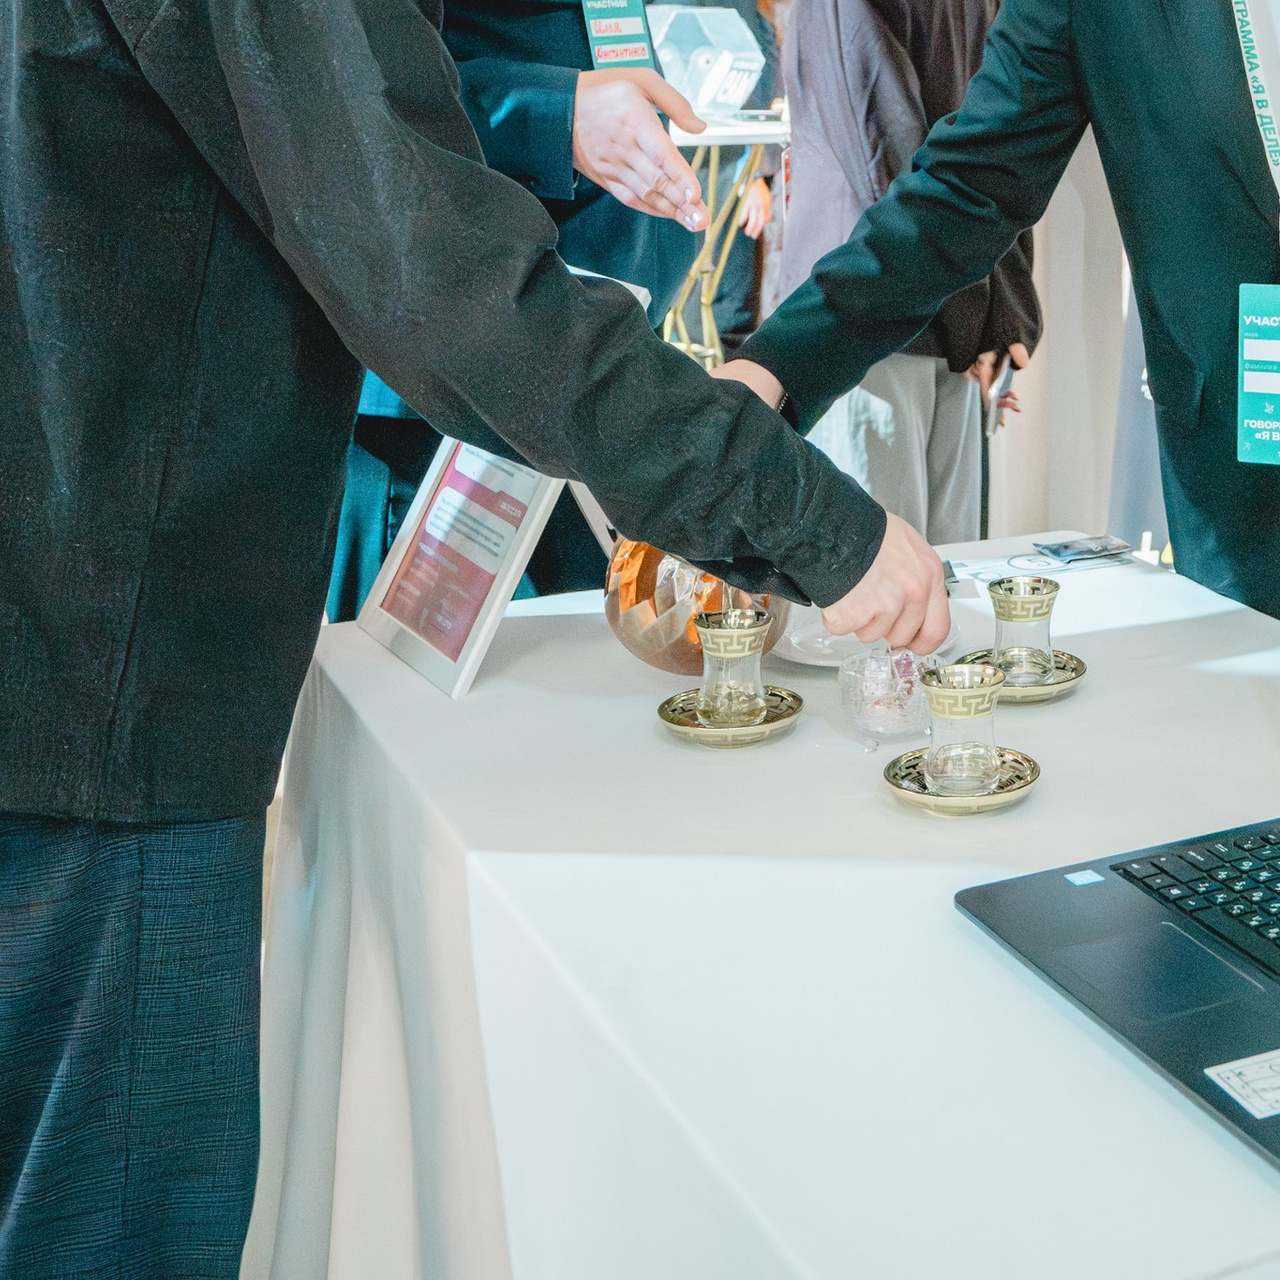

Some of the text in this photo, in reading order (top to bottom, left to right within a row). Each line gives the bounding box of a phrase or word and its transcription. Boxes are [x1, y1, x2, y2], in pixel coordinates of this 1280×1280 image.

[1251, 75, 1265, 94] «Я
[1256, 99, 1269, 109] В
[1255, 431, 1270, 441] «Я
[1272, 432, 1280, 441] В
